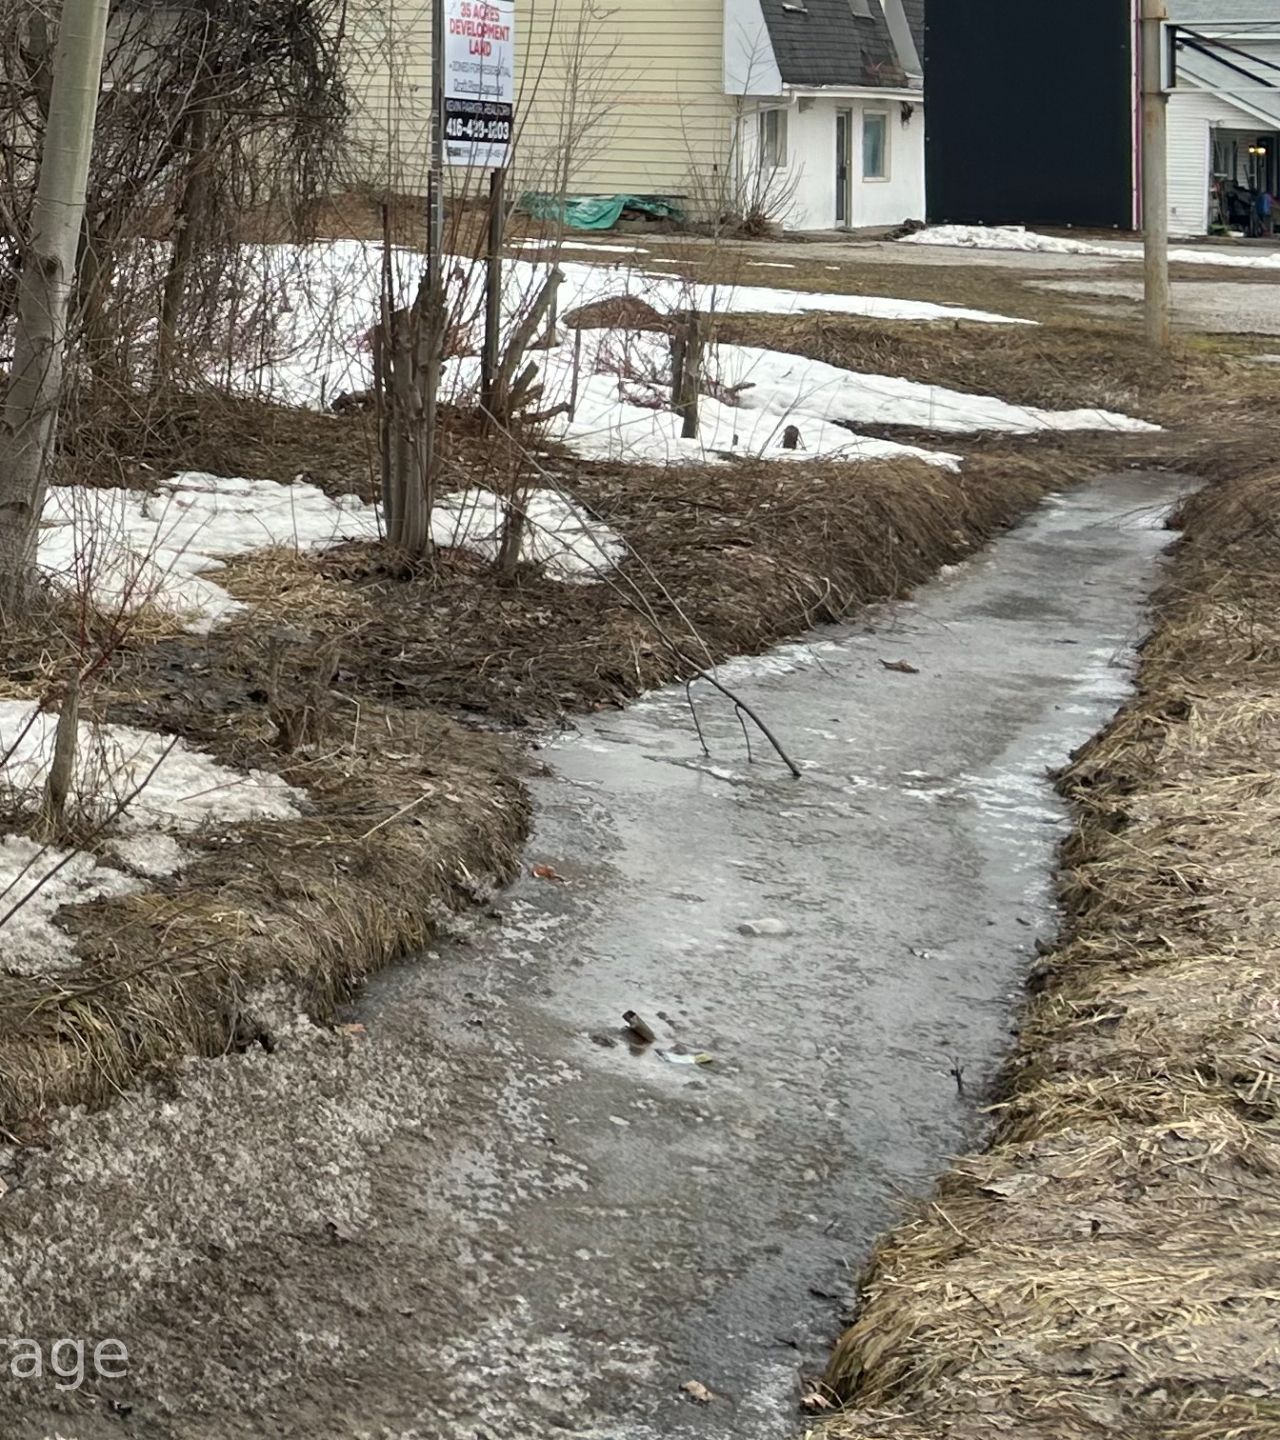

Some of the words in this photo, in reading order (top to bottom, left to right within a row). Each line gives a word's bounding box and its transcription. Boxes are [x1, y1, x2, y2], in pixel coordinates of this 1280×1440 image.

[460, 2, 471, 18] 35
[473, 4, 500, 22] ACRES
[449, 19, 510, 41] DEVELOPMENT
[469, 39, 491, 56] LAND
